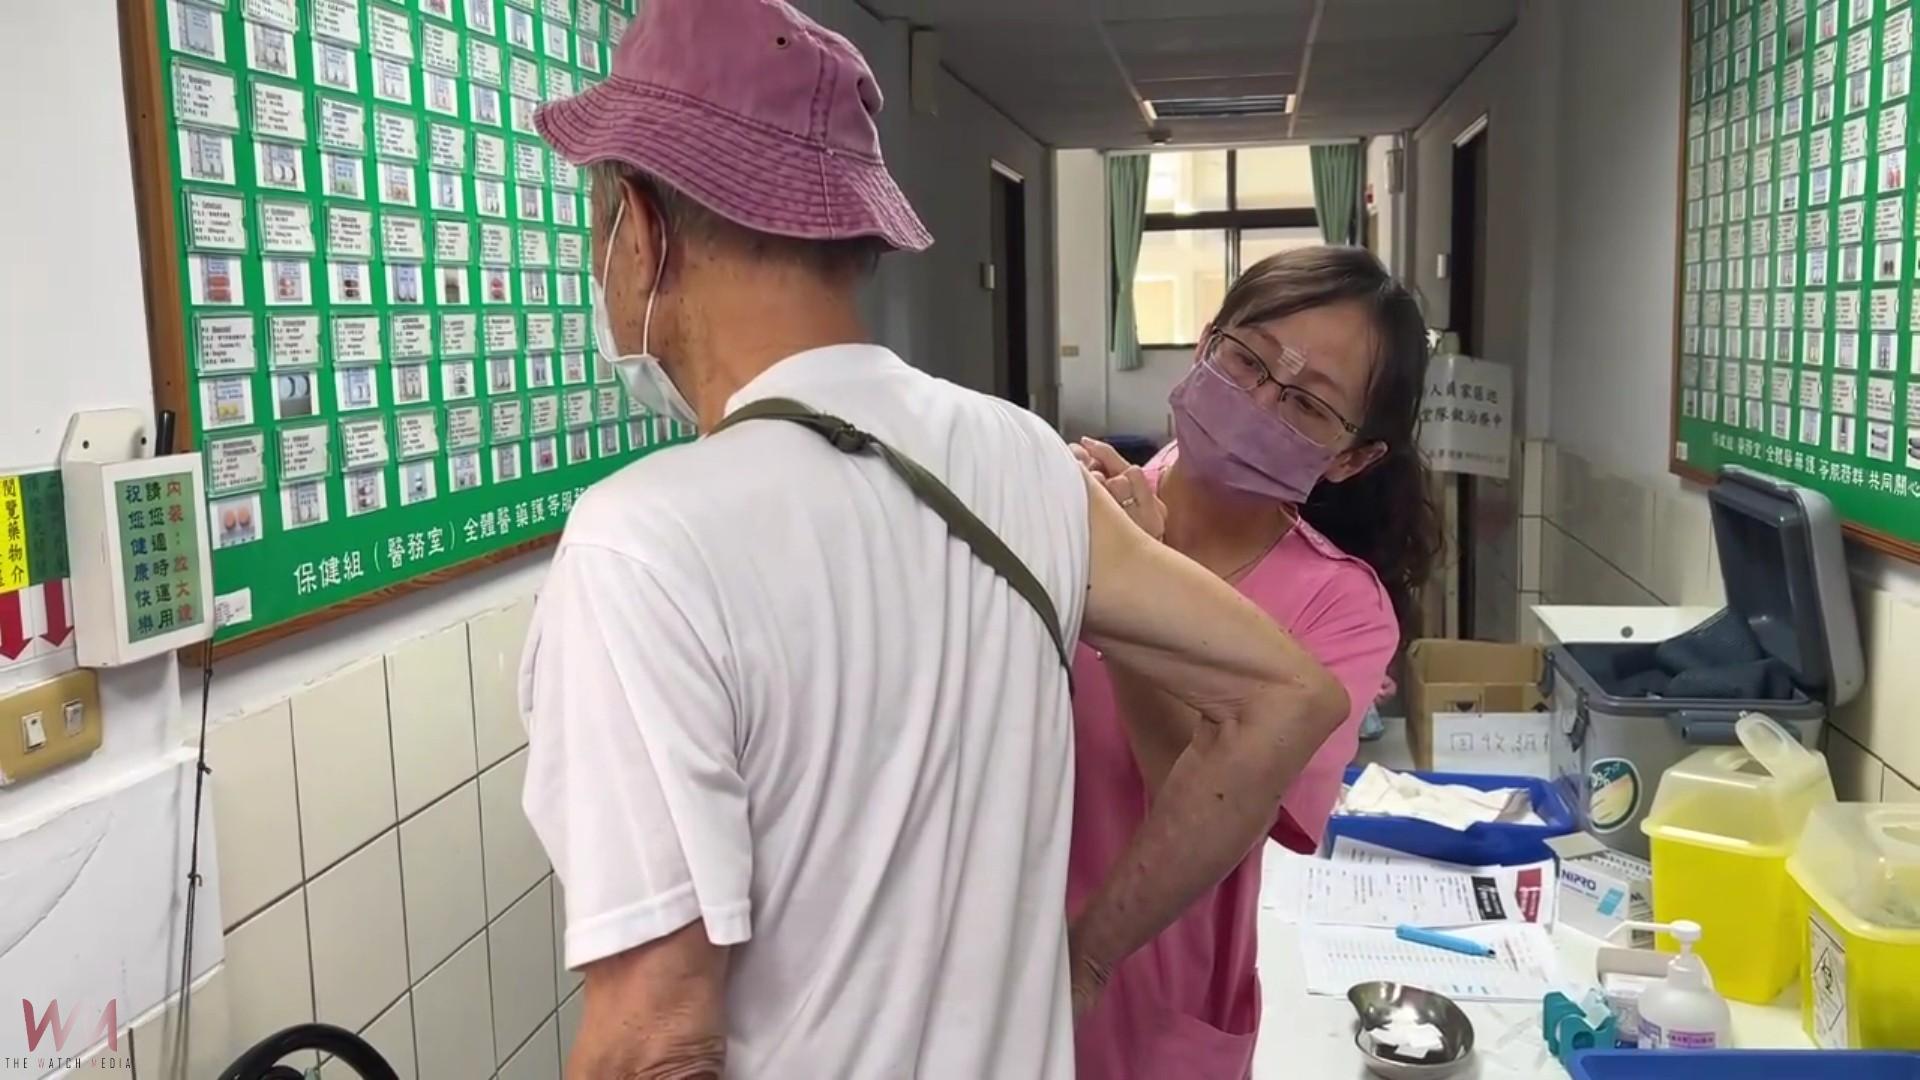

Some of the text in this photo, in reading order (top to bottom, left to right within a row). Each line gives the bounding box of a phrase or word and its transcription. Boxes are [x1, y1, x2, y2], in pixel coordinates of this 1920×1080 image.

[125, 484, 154, 635] 祝您健康快樂
[1561, 868, 1598, 892] NIPRO
